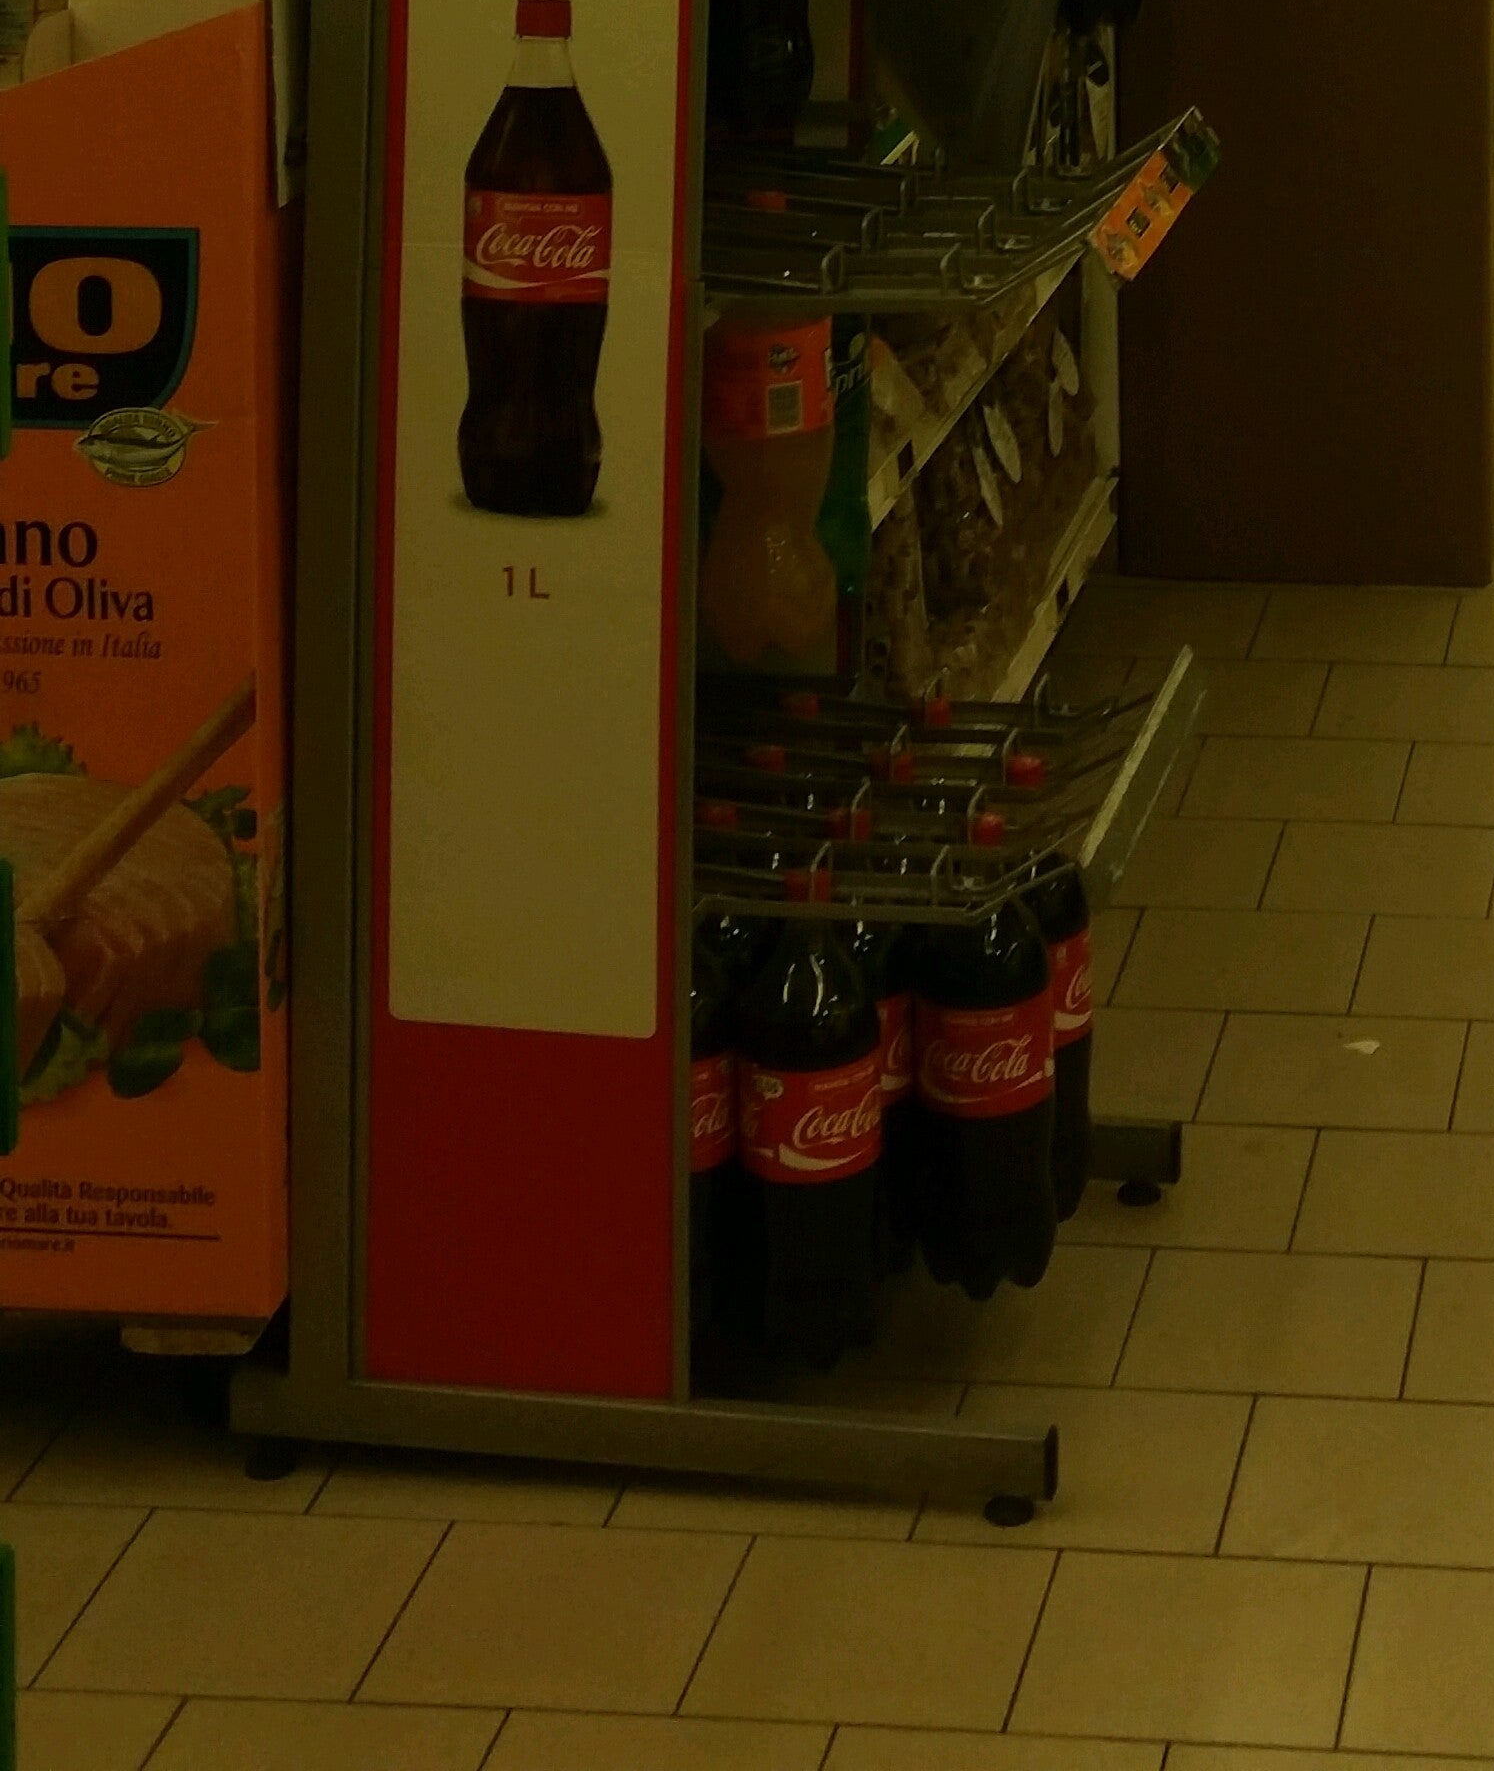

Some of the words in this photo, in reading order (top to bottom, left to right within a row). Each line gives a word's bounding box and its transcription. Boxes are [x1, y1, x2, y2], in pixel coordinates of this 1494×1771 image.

[502, 565, 514, 598] 1
[529, 567, 550, 600] L
[45, 576, 154, 622] Oliva
[71, 633, 94, 658] in
[102, 631, 162, 660] Italia
[79, 1180, 216, 1207] Responsabile
[24, 1203, 59, 1224] alla
[66, 1206, 98, 1226] tua
